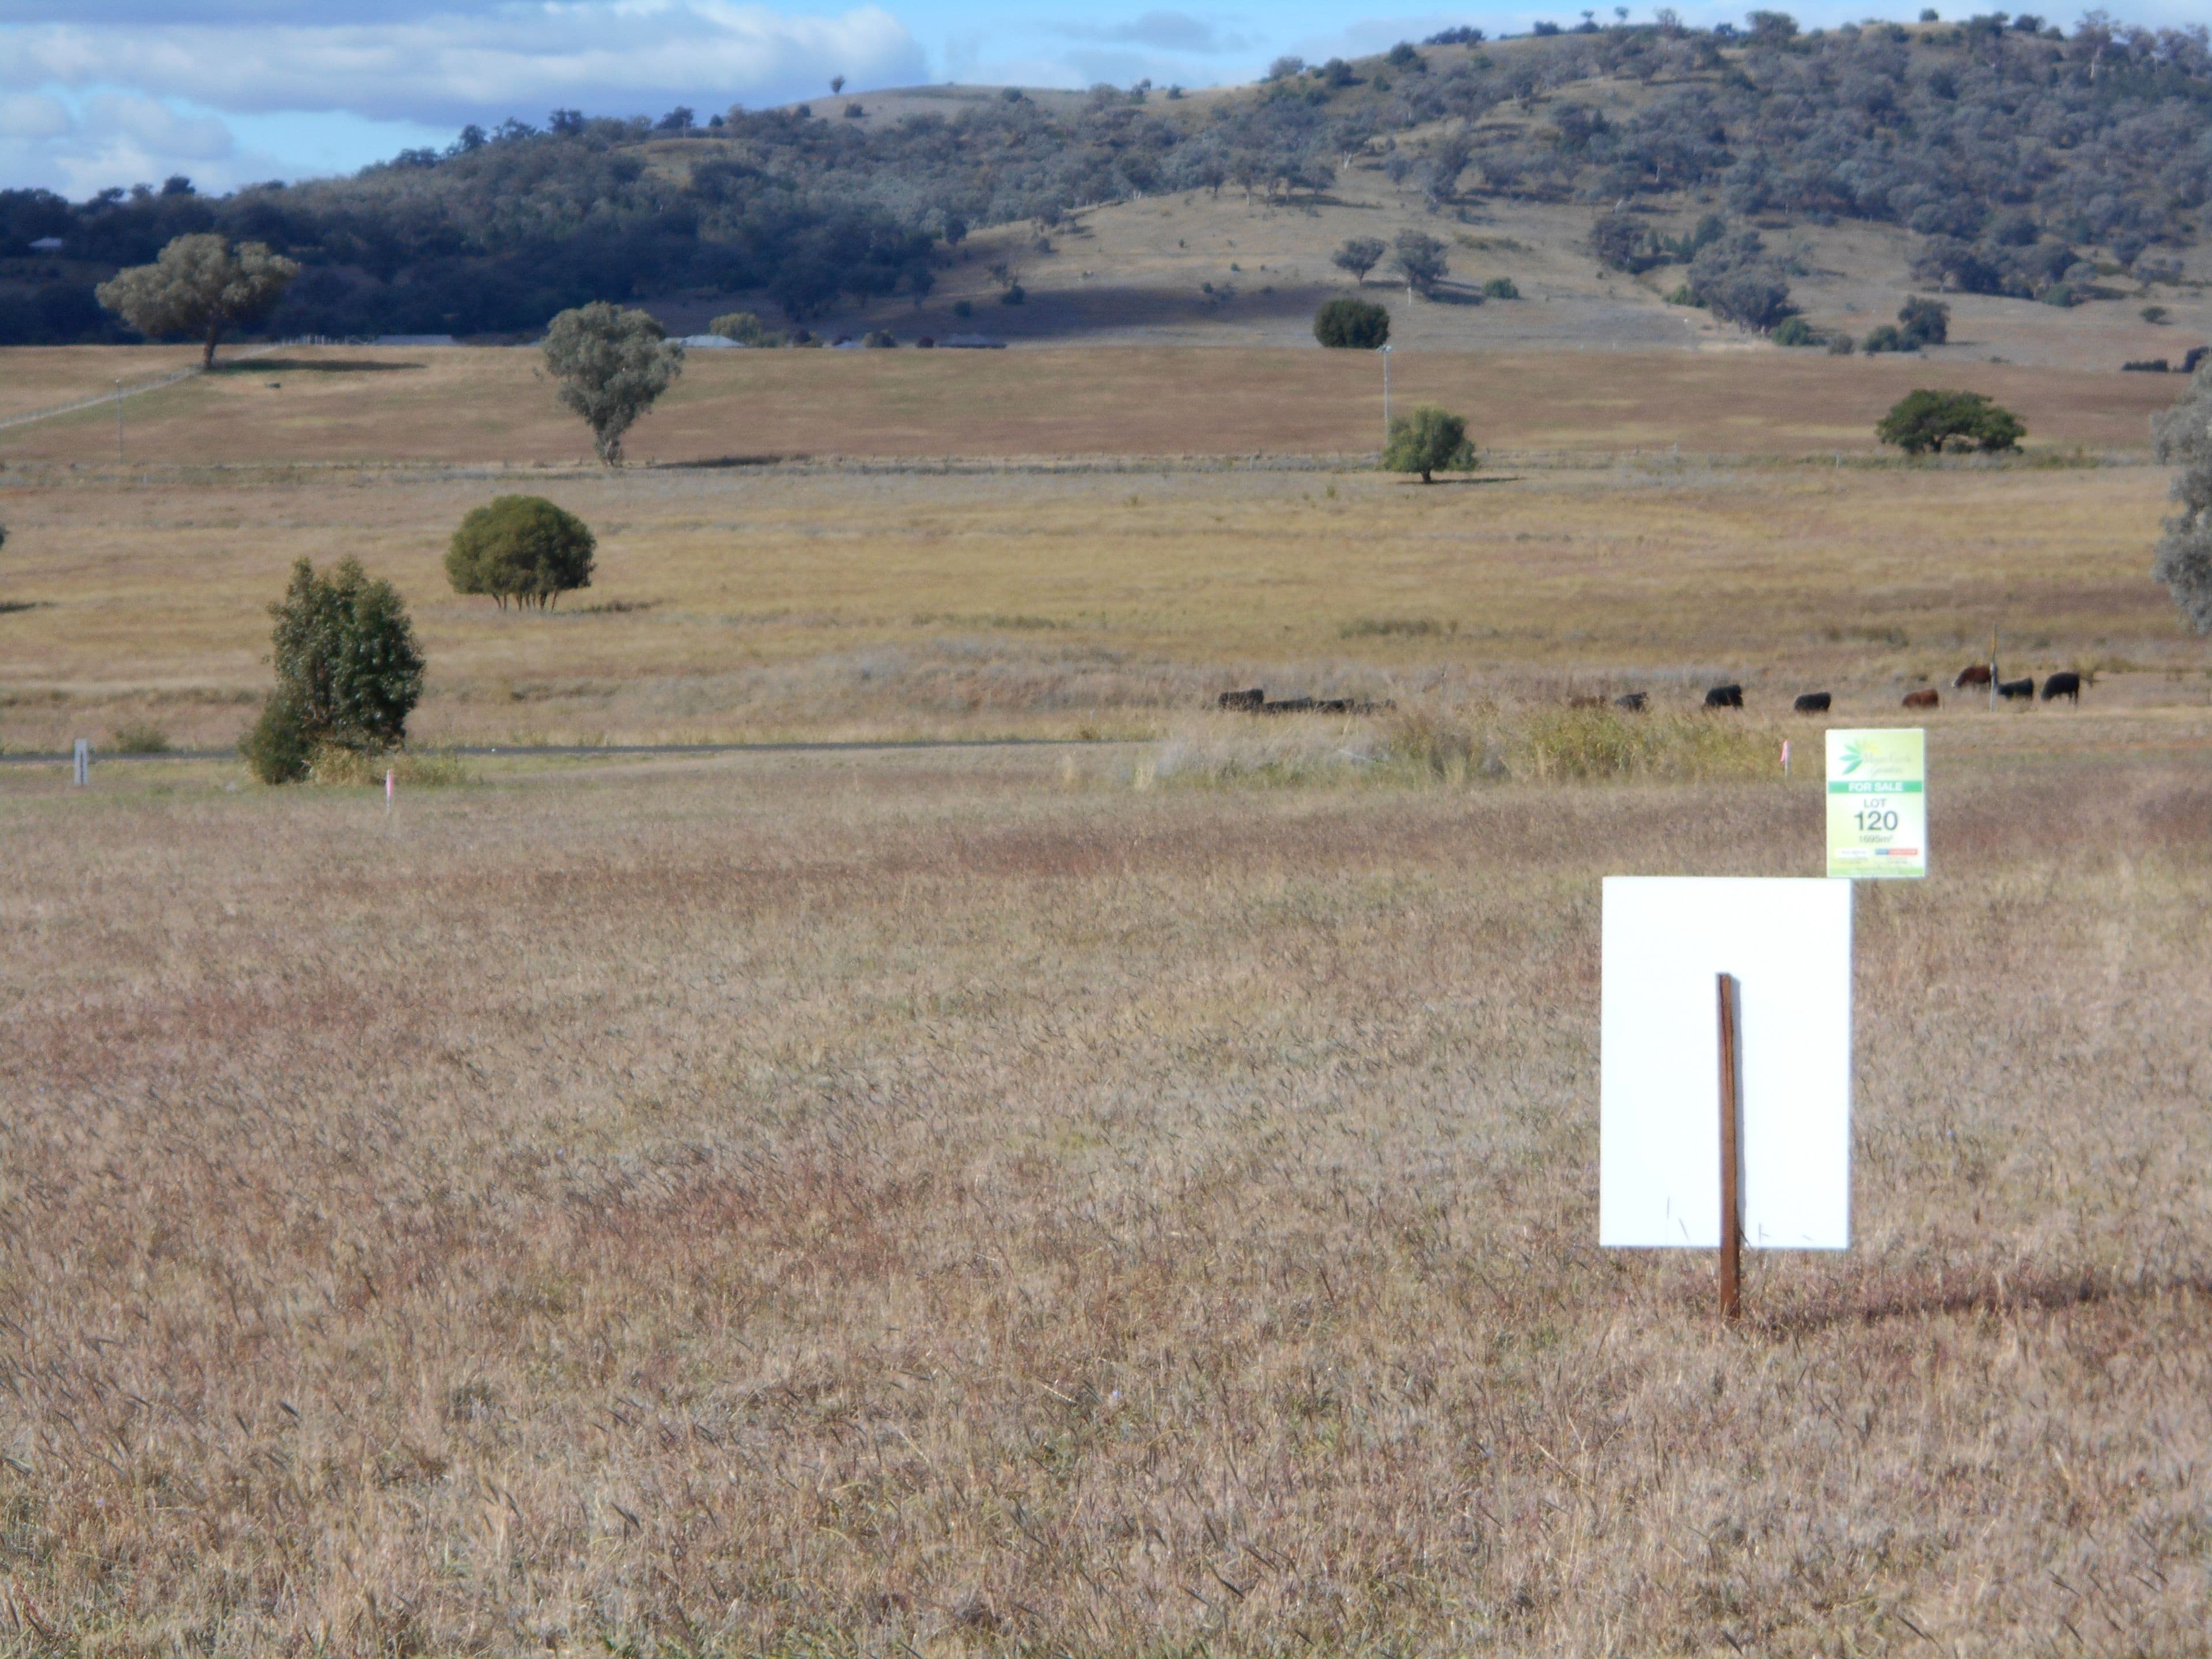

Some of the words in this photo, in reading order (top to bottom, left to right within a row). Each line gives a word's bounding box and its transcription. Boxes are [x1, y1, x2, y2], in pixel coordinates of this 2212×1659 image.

[1849, 782, 1872, 792] FOR
[1874, 782, 1903, 792] SALE
[1864, 798, 1887, 808] LOT
[1854, 810, 1898, 831] 120
